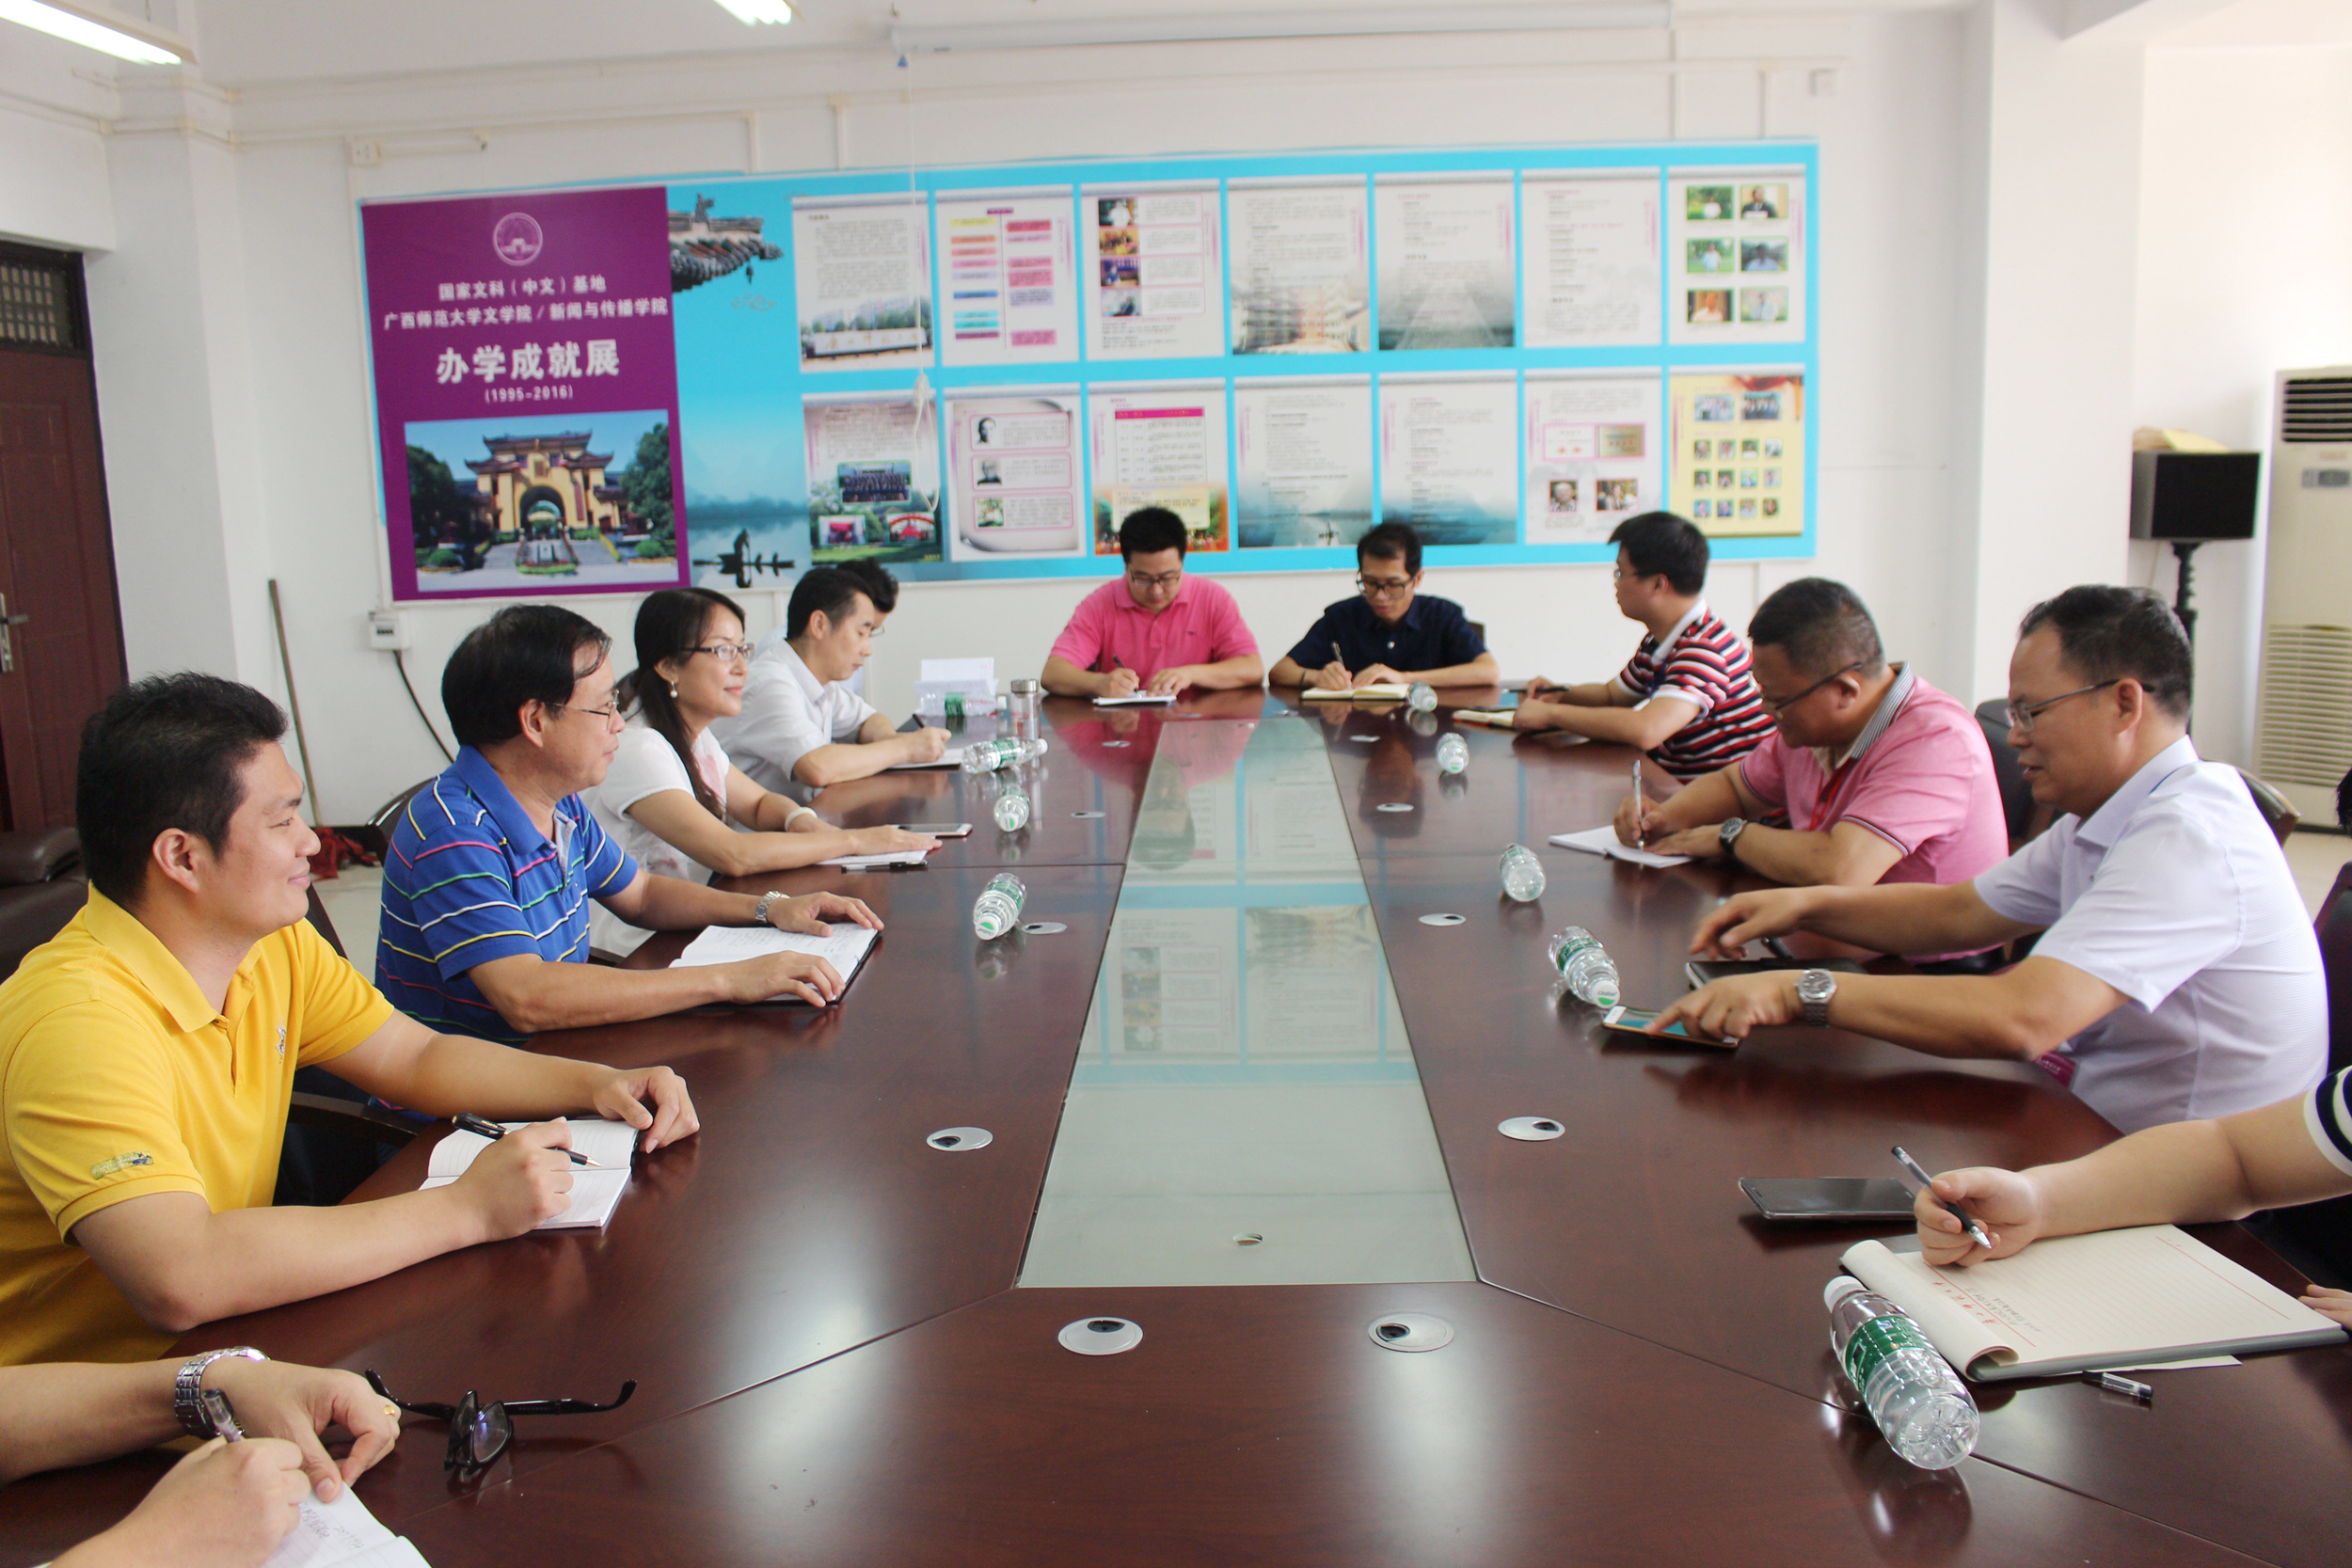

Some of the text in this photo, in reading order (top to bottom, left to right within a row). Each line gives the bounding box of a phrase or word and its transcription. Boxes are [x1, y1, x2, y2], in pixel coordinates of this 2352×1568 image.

[437, 339, 620, 384] 办学成就展
[485, 385, 574, 404] (1995-2016)
